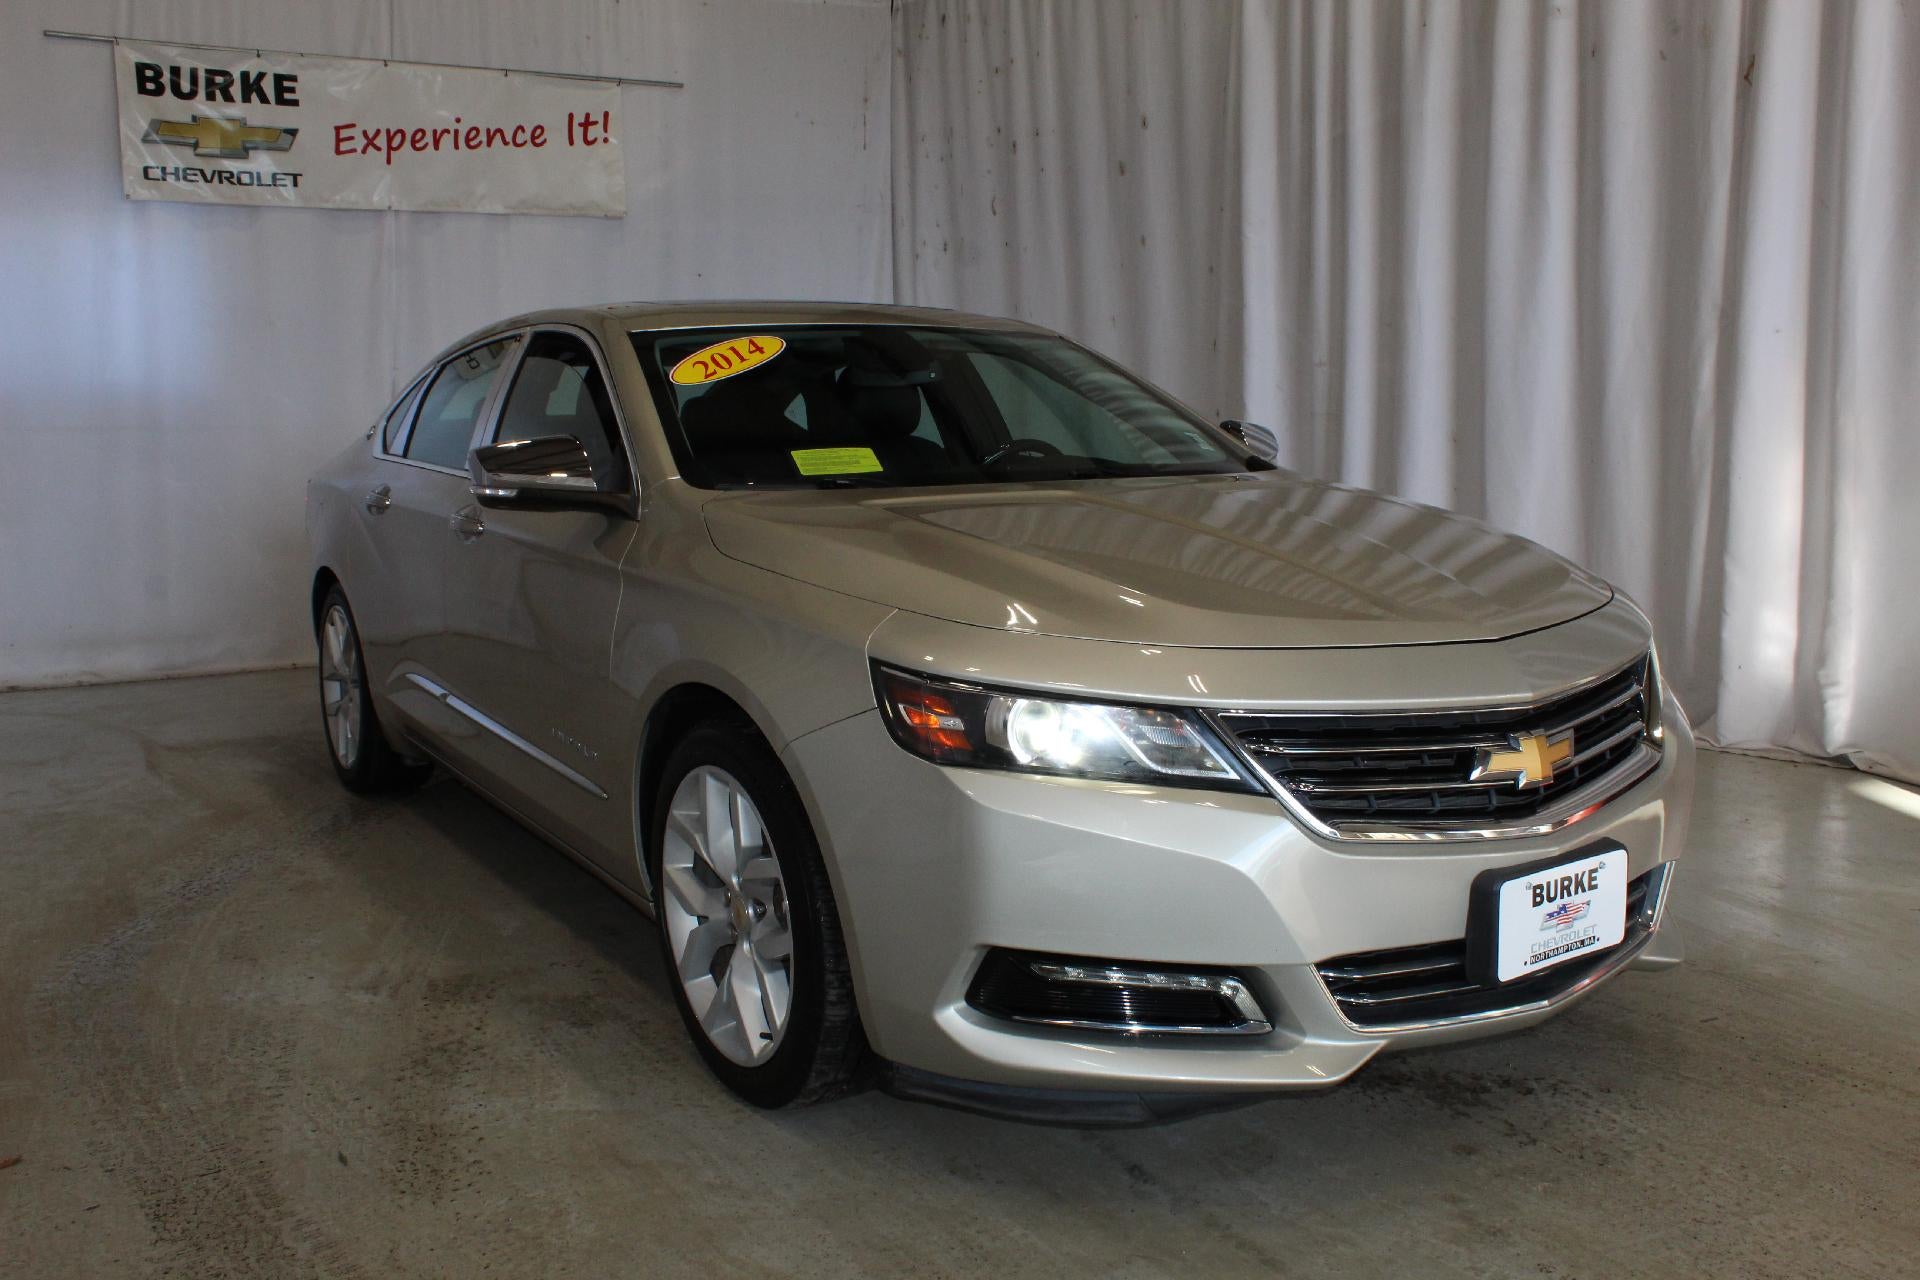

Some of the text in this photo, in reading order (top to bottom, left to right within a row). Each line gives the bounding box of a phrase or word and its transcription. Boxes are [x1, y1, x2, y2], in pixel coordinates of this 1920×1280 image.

[135, 62, 299, 106] BURKE
[333, 110, 609, 165] Experience It!
[143, 165, 302, 187] CHEVROLET
[692, 338, 766, 380] 2014
[1532, 867, 1599, 907] BURKE
[1530, 924, 1598, 953] CHEVROLET
